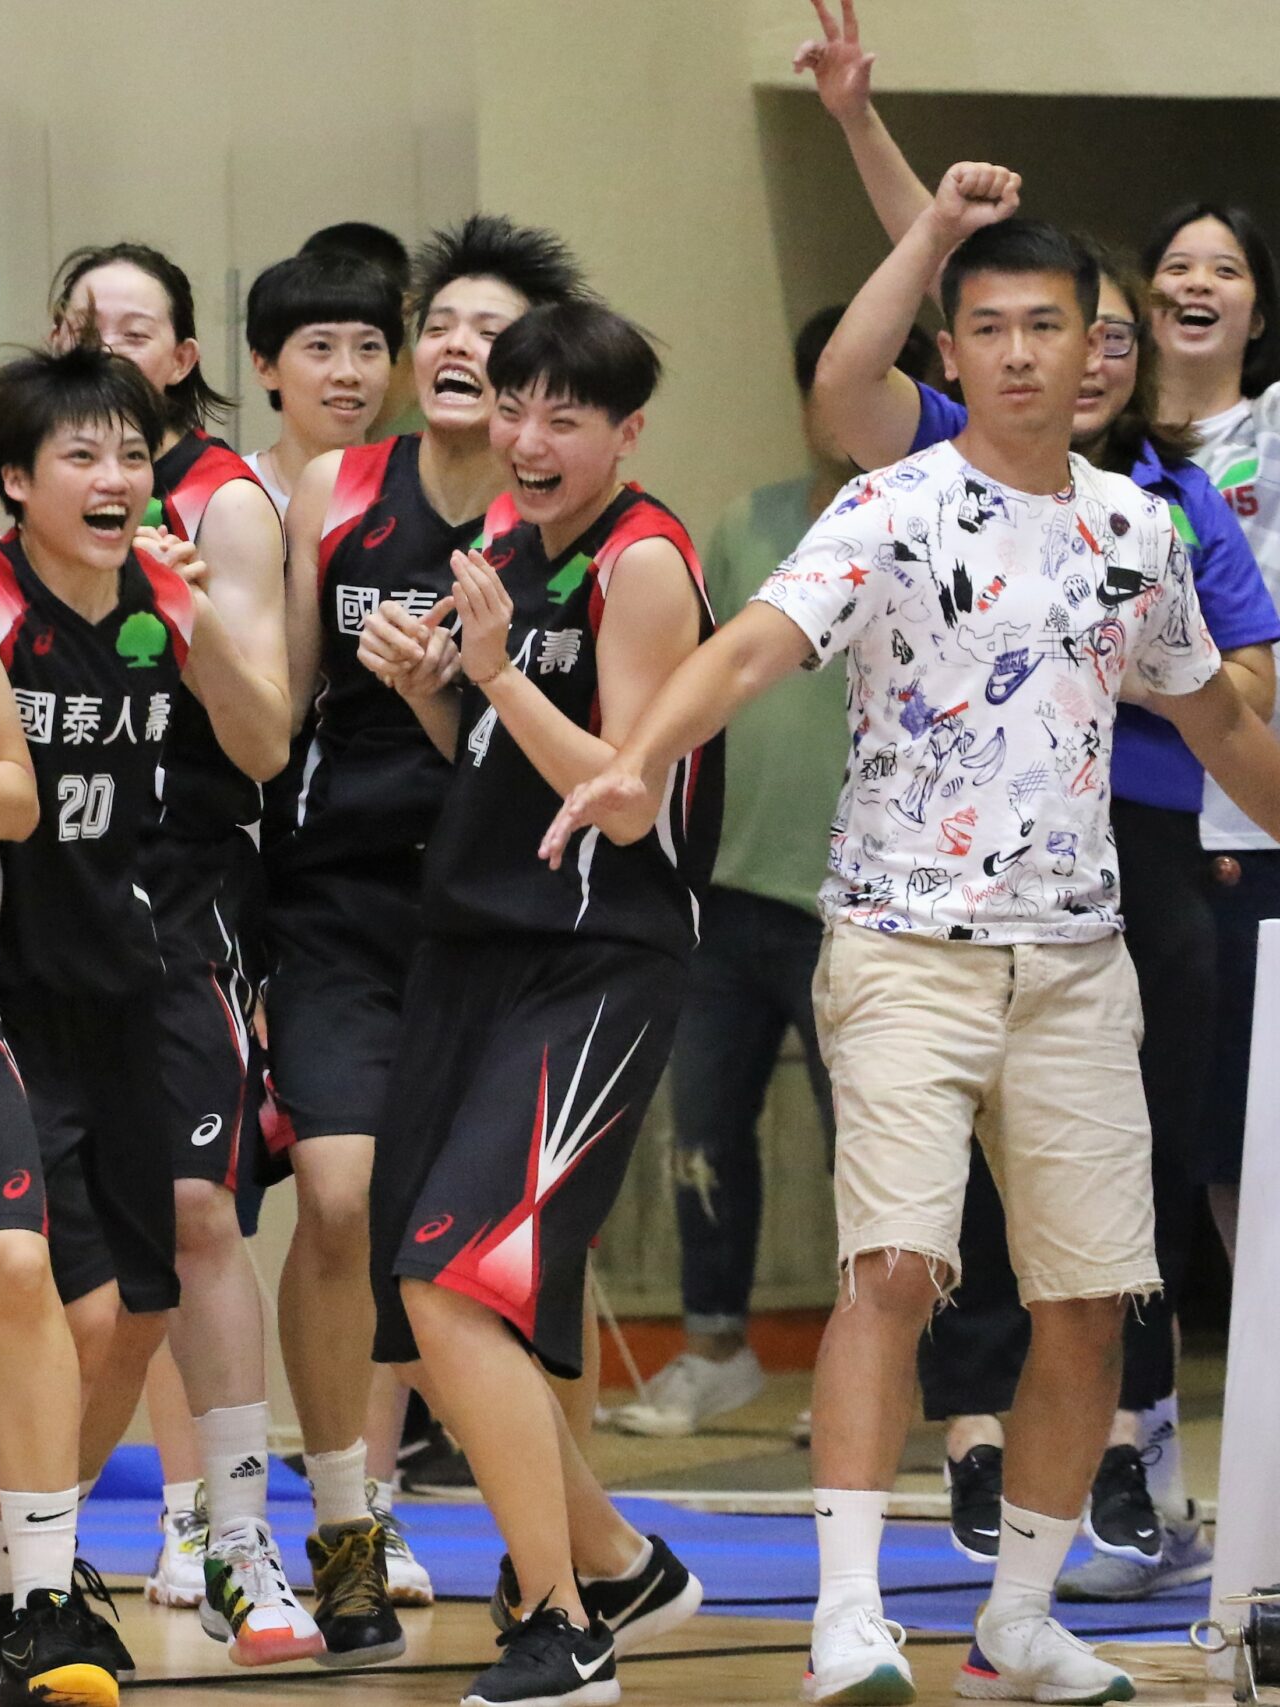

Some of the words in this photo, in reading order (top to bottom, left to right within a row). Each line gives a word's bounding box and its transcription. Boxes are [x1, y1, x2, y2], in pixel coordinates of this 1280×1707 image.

[12, 687, 171, 745] 國泰人壽
[57, 773, 116, 842] 20
